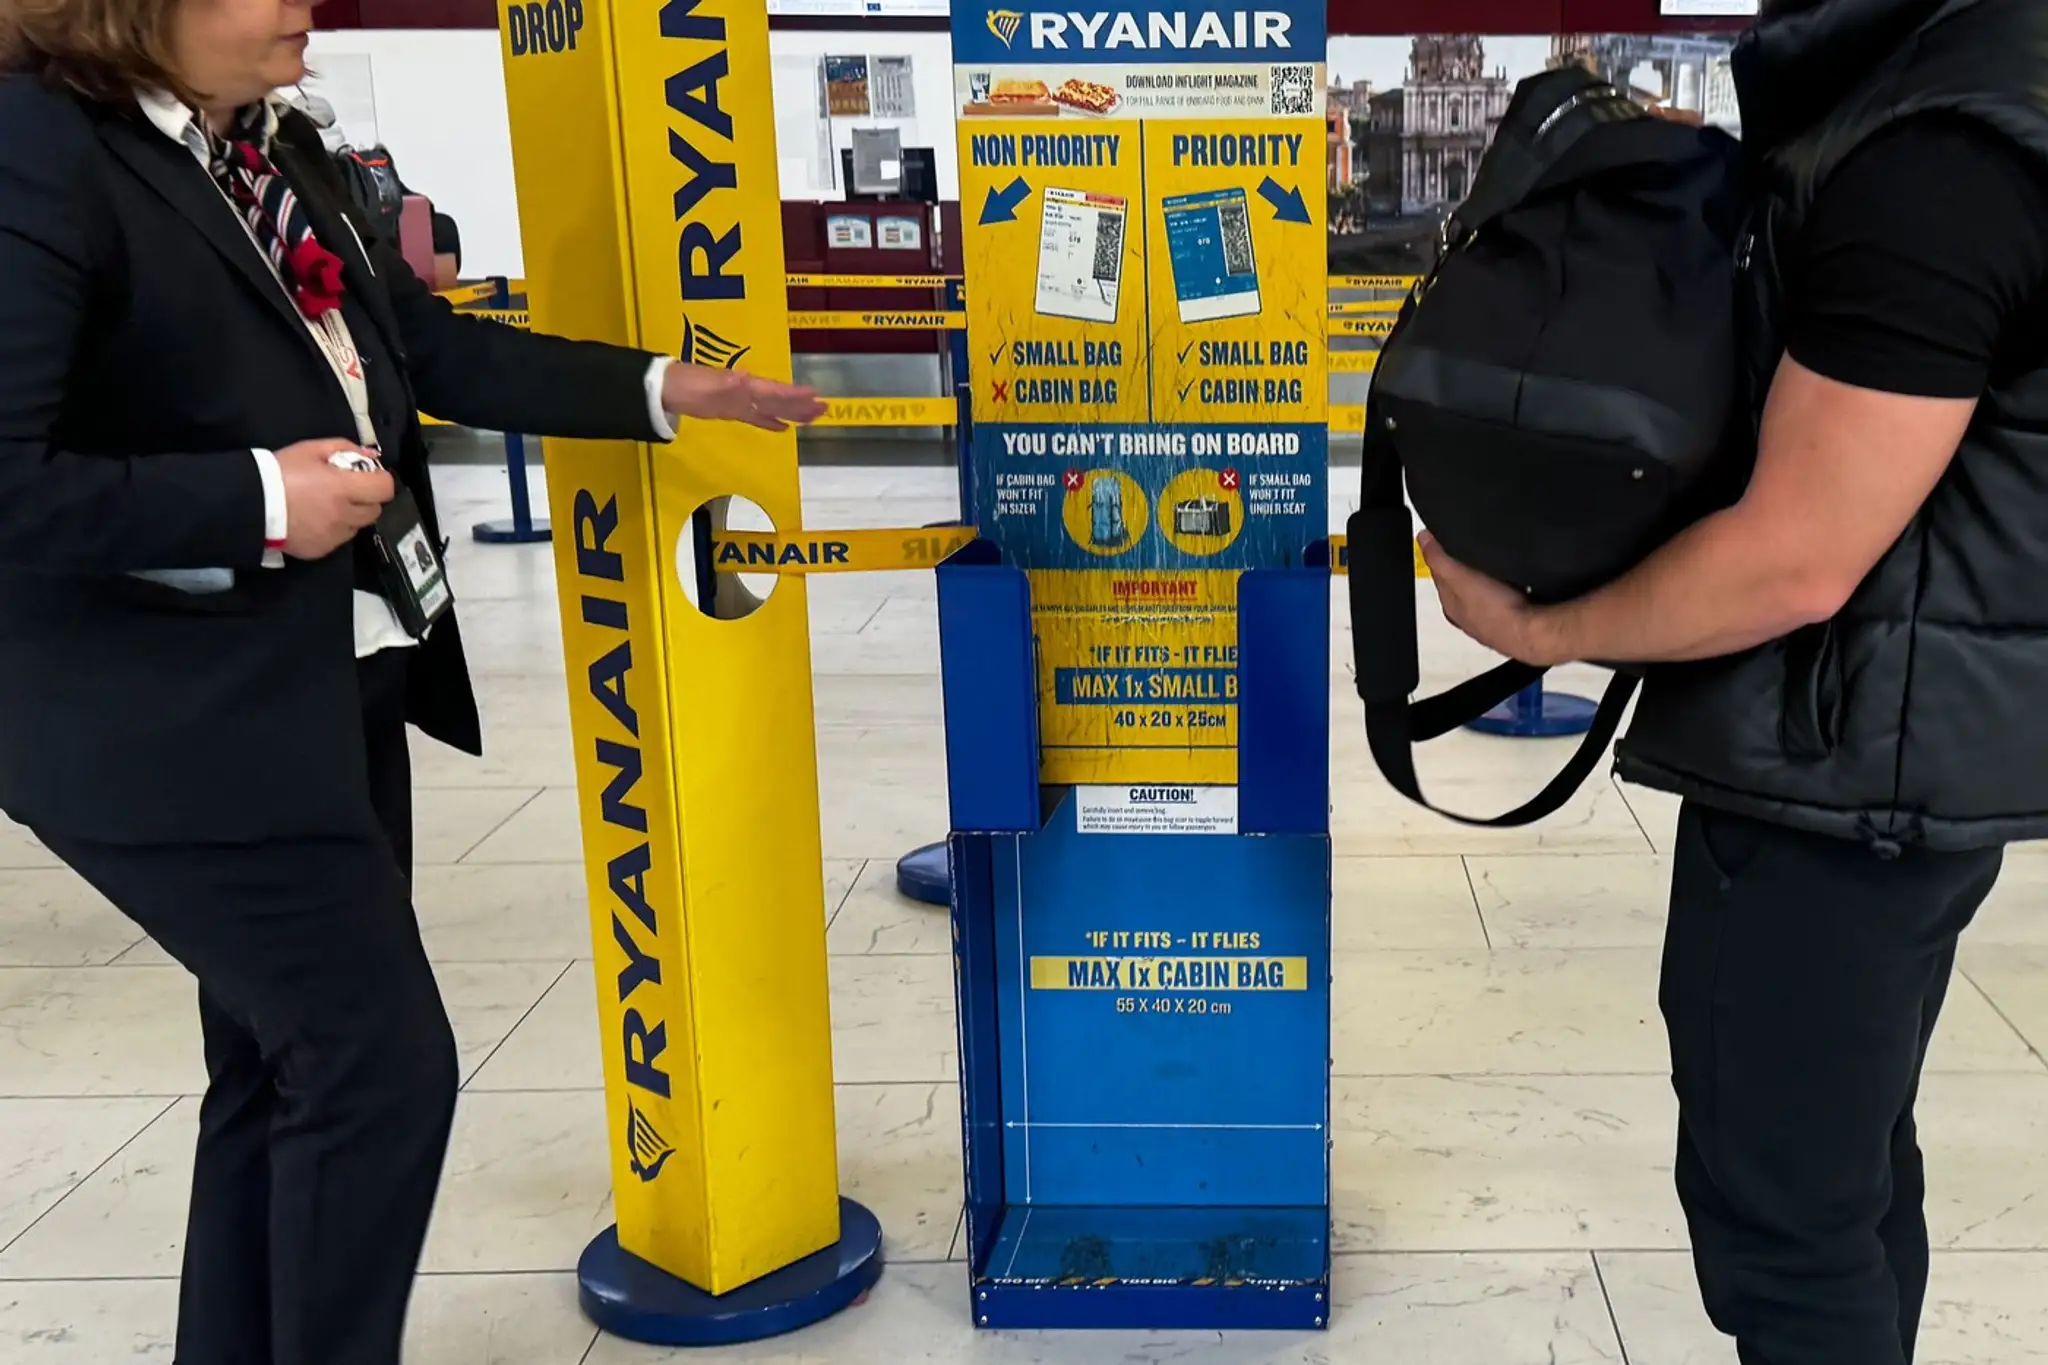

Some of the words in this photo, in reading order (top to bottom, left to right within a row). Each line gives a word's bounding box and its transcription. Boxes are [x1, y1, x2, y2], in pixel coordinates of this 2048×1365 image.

[508, 0, 584, 56] DROP
[1031, 11, 1292, 49] RYANAIR
[1126, 74, 1173, 89] DOWNLOAD
[1175, 74, 1213, 89] INFLIGHT
[1214, 74, 1258, 90] MAGAZINE
[972, 133, 1015, 167] NON
[1023, 133, 1121, 167] PRIORITY
[1173, 133, 1303, 167] PRIORITY
[874, 315, 945, 326] RYANAIR
[1013, 341, 1079, 367] SMALL
[1084, 341, 1122, 367] BAG
[1200, 341, 1264, 367] SMALL
[1269, 341, 1308, 367] BAG
[1015, 379, 1074, 405] CABIN
[1079, 379, 1118, 405] BAG
[1200, 379, 1259, 404] CABIN
[1264, 379, 1302, 404] BAG
[1002, 432, 1047, 457] YOU
[1051, 432, 1115, 457] CAN'T
[1119, 432, 1187, 457] BRING
[1191, 432, 1222, 457] ON
[1227, 432, 1300, 457] BOARD
[996, 473, 1004, 487] IF
[1006, 473, 1035, 488] CABIN
[1036, 473, 1056, 487] BAG
[1249, 473, 1258, 486] IF
[1259, 473, 1291, 487] SMALL
[1292, 473, 1312, 487] BAG
[1028, 488, 1043, 501] FIT
[1281, 488, 1296, 500] FIT
[1009, 502, 1037, 516] SIZER
[1249, 502, 1282, 515] UNDER
[1282, 502, 1307, 515] SEAT
[712, 541, 850, 565] ANAIR
[1112, 580, 1198, 597] IMPORTANT
[1115, 645, 1131, 663] IT
[1134, 645, 1170, 663] FITS
[1184, 645, 1200, 663] IT
[1203, 645, 1238, 663] FLIE
[1072, 674, 1119, 699] MAX
[1124, 674, 1144, 698] 1x
[1149, 674, 1220, 699] SMALL
[1114, 710, 1135, 728] 40
[1139, 714, 1147, 727] x
[1151, 710, 1171, 728] 20
[1176, 714, 1183, 727] x
[574, 488, 672, 1100] RYANAIR
[1129, 788, 1194, 802] CAUTION!
[1113, 931, 1130, 948] IT
[1134, 931, 1171, 948] FITS
[1191, 931, 1209, 948] IT
[1213, 931, 1260, 949] FLIES
[1067, 960, 1120, 988] MAX
[1157, 960, 1230, 989] CABIN
[1237, 960, 1285, 988] BAG
[1116, 998, 1136, 1013] 55
[1139, 998, 1149, 1013] X
[1151, 998, 1170, 1013] 40
[1174, 998, 1185, 1013] X
[1188, 998, 1207, 1014] 20
[1210, 1002, 1231, 1015] cm
